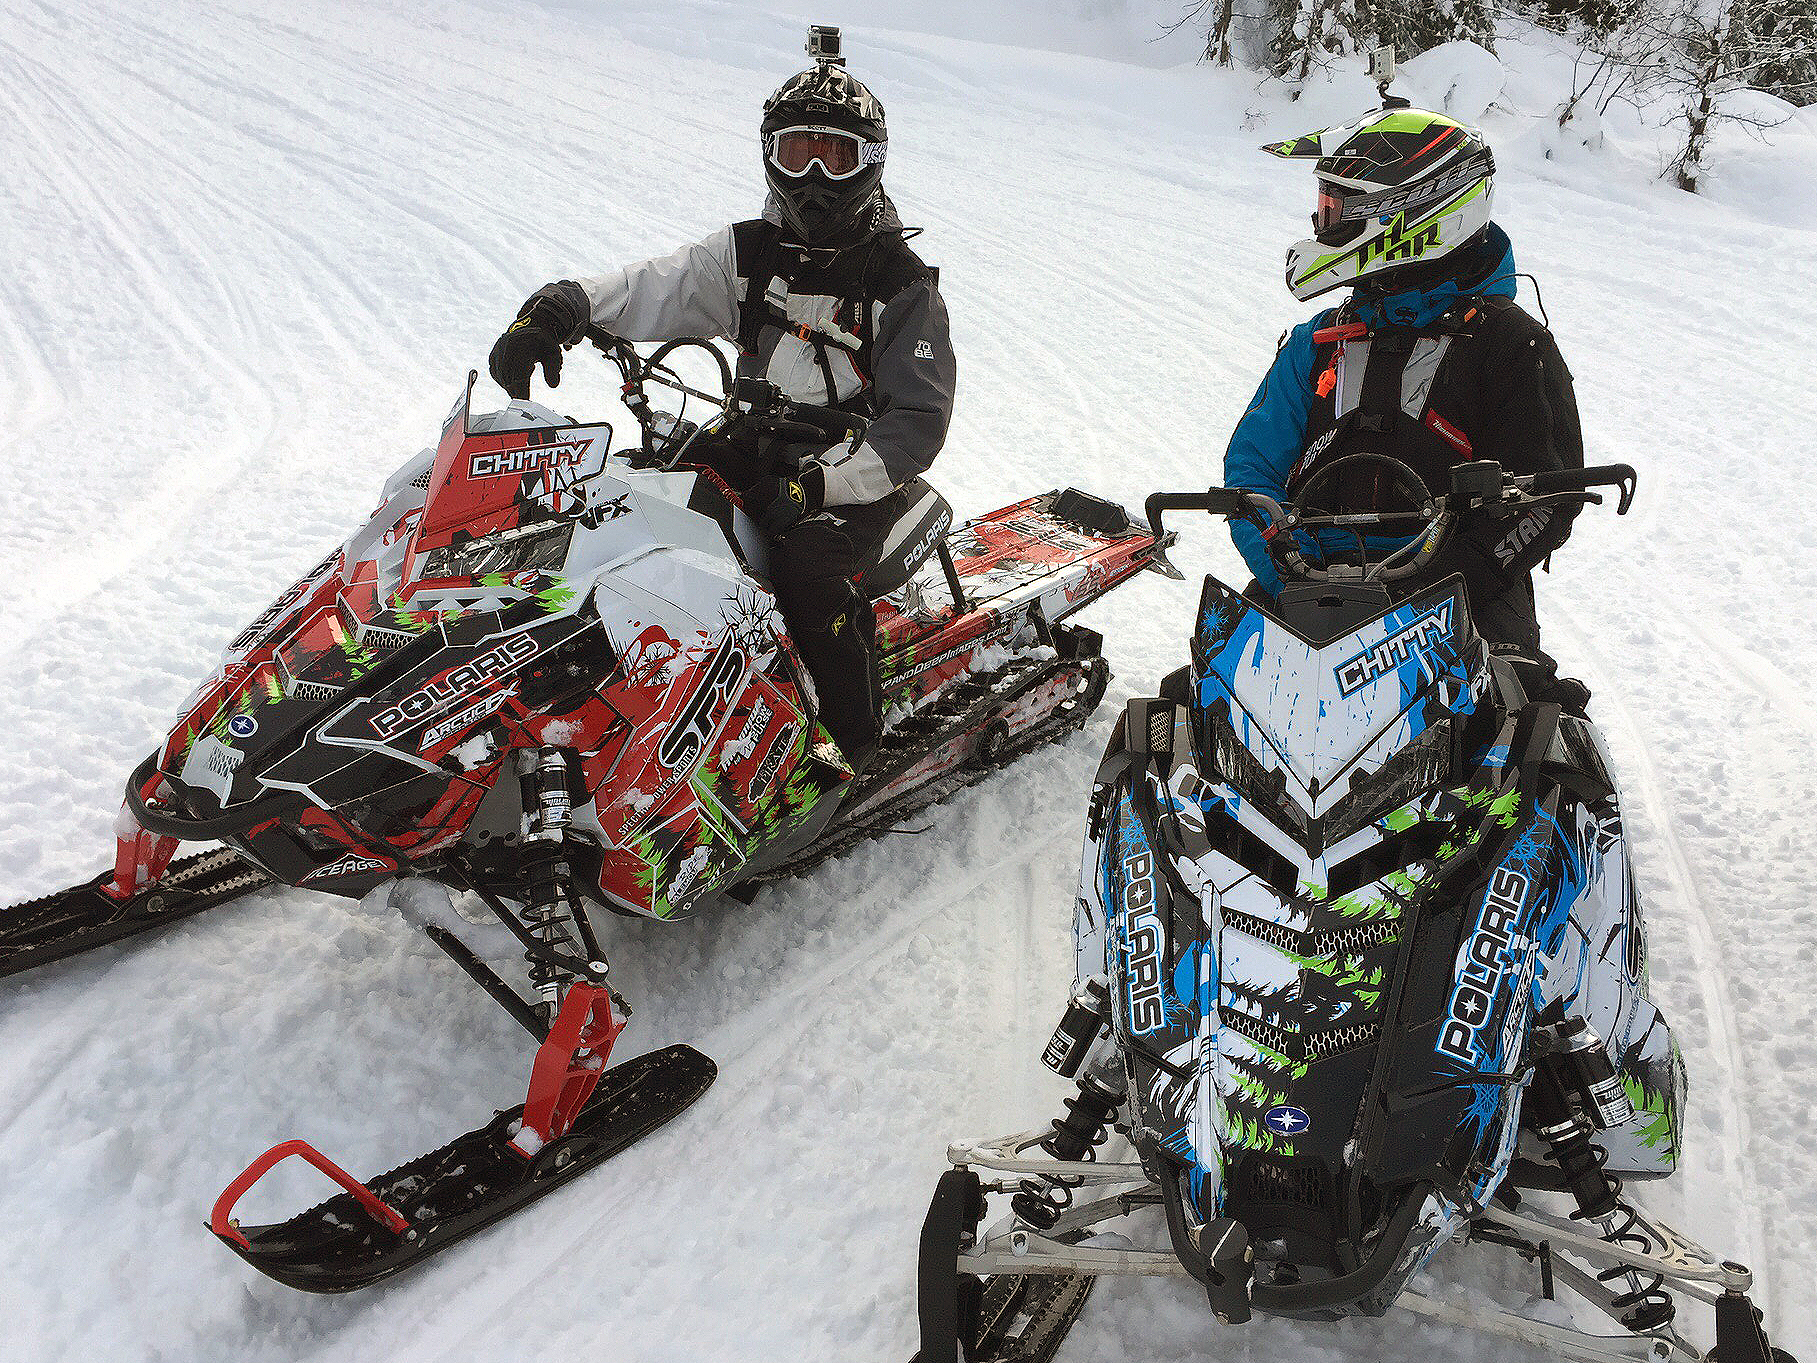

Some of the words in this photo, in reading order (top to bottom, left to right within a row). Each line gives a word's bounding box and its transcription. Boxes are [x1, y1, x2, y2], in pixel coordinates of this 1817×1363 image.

[471, 443, 590, 478] CHITTY
[903, 509, 951, 571] POLARIS
[369, 632, 540, 738] POLARIS
[1336, 602, 1454, 697] CHITTY
[672, 745, 697, 778] SPORTS
[1124, 852, 1167, 1035] POLARIS
[1436, 867, 1530, 1064] POLARIS
